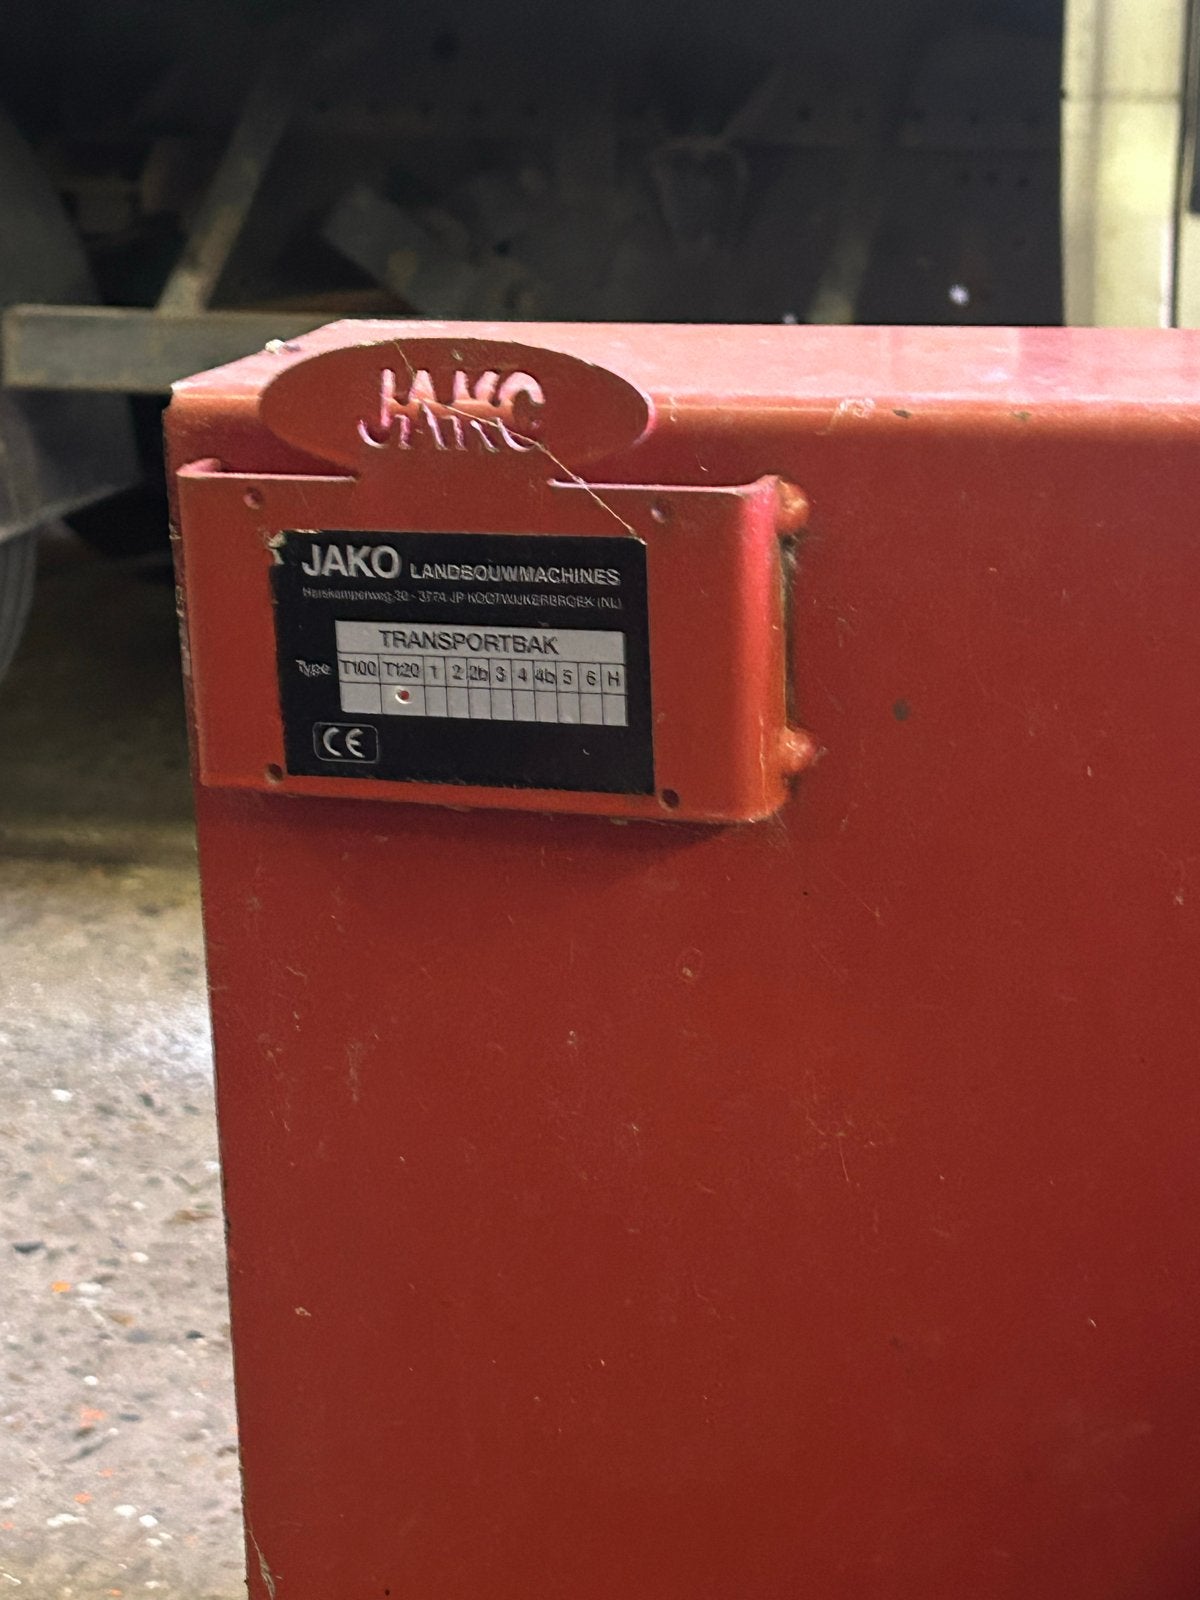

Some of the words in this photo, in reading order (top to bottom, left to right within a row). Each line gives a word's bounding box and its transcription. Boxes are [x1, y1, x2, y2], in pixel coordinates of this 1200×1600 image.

[302, 544, 401, 580] JAKO
[410, 562, 621, 587] LANDBOUWMACHINES
[379, 629, 559, 655] TRANSPORTBAK
[339, 658, 377, 677] T100
[430, 664, 438, 680] 1
[452, 664, 463, 681] 2
[468, 663, 489, 682] 2b
[495, 665, 505, 682] 3
[517, 666, 527, 683] 4
[535, 666, 556, 685] 4b
[562, 667, 572, 684] 5
[587, 669, 597, 686] 6
[609, 670, 620, 687] H
